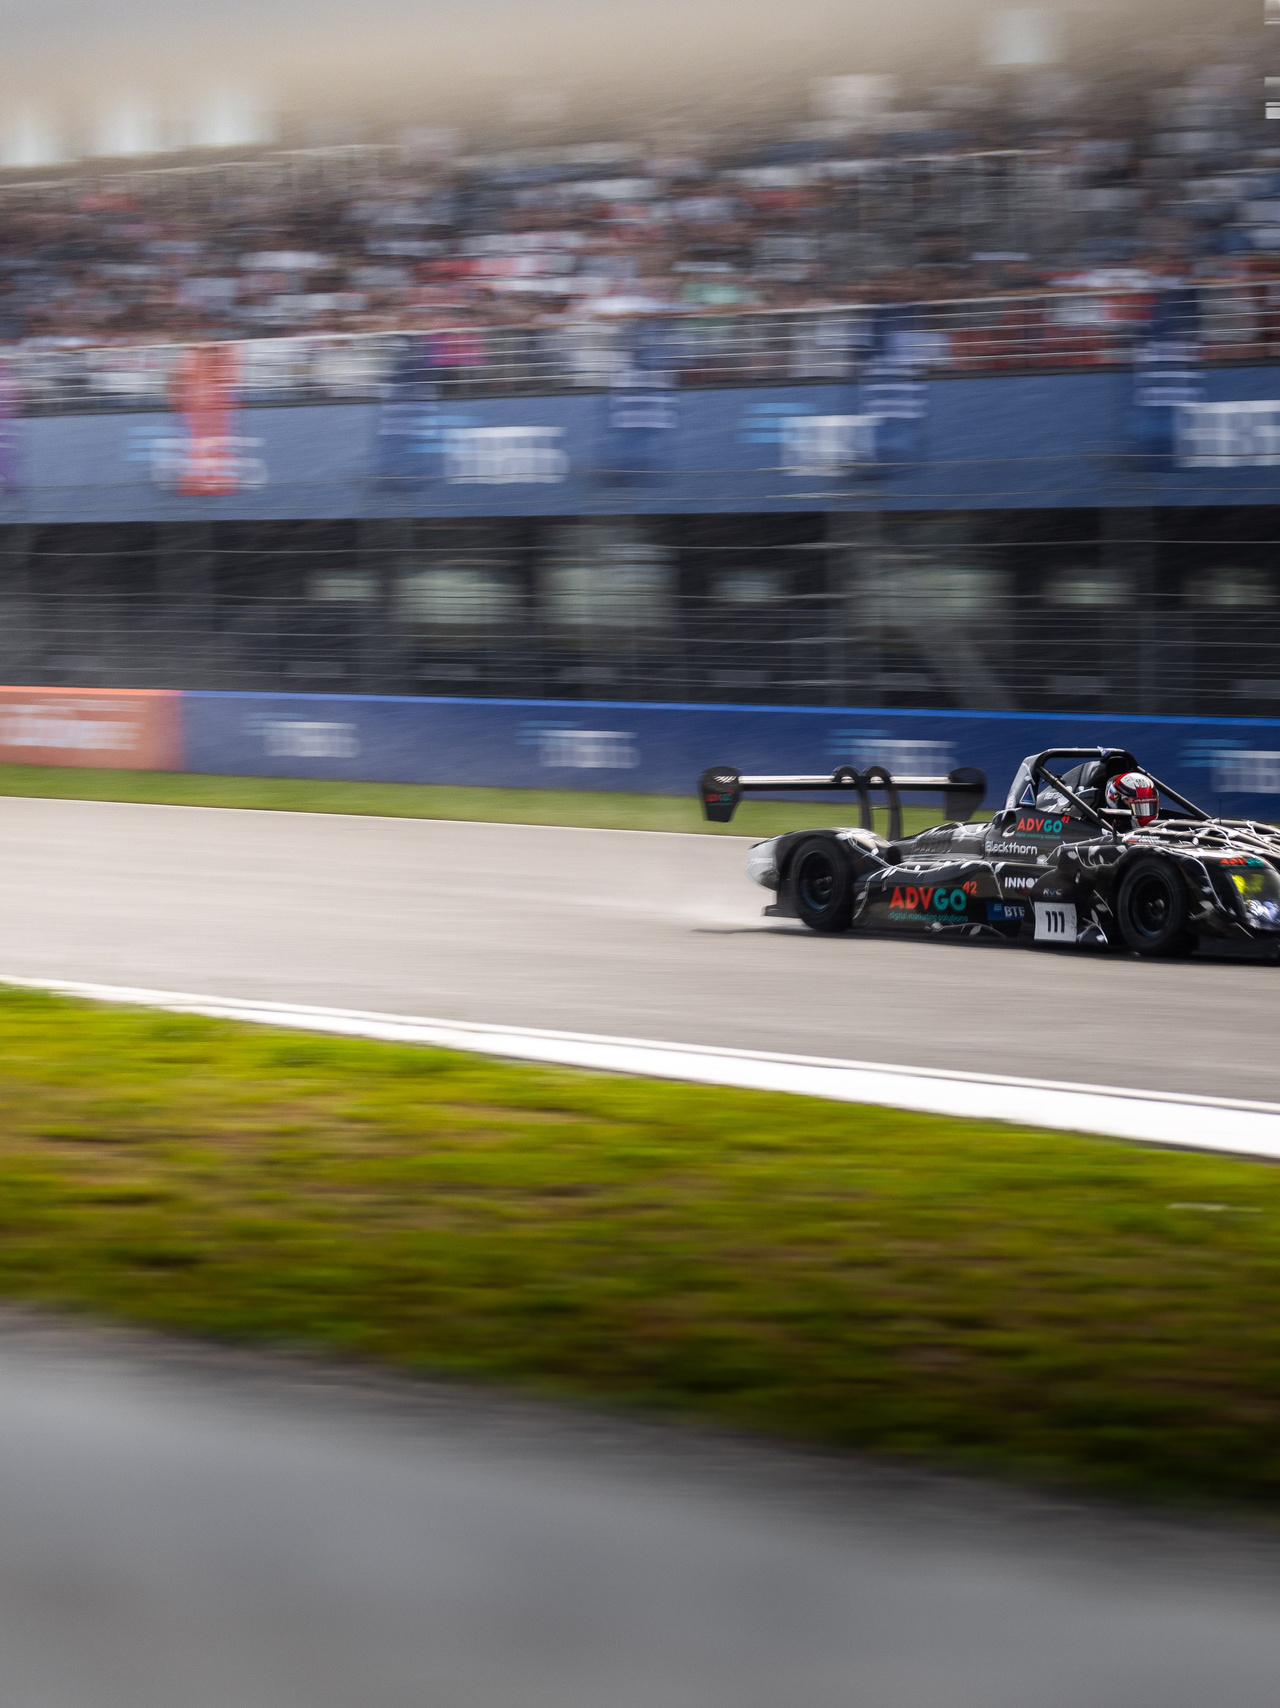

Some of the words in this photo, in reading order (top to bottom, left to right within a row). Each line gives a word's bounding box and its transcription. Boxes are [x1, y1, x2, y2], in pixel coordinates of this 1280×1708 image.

[1017, 818, 1062, 833] ADVGO
[985, 841, 1037, 855] Blackthorn
[889, 886, 967, 911] ADVGO
[962, 881, 977, 894] 42
[938, 914, 968, 922] solutions
[1045, 910, 1065, 934] 111
